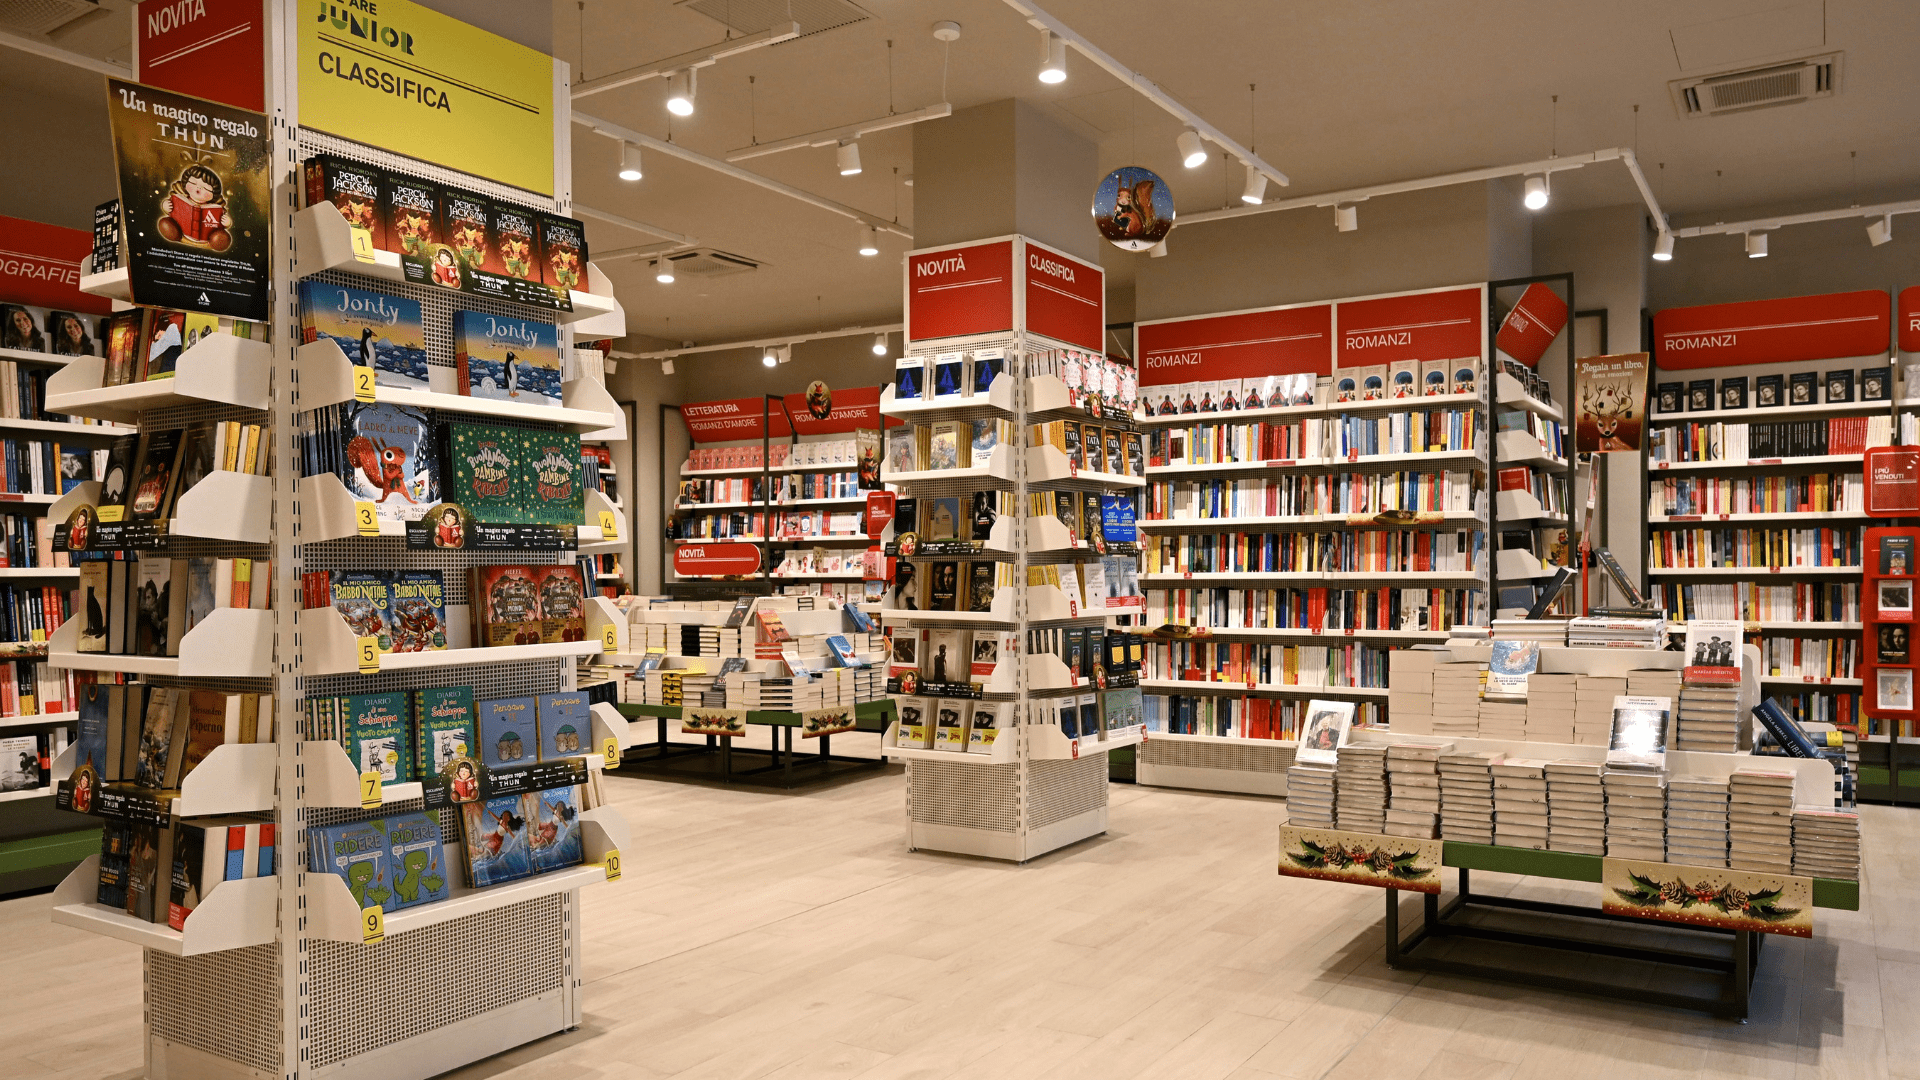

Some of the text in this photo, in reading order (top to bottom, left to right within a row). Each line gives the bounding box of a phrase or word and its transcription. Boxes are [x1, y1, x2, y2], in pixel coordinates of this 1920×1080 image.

[318, 1, 414, 56] JUNIOR
[318, 51, 452, 114] CLASSIFICA
[119, 88, 258, 138] Un magico regalo
[157, 122, 224, 150] THUN
[338, 170, 370, 185] PERCY
[332, 176, 378, 197] JACKSON
[397, 186, 426, 199] PERCY
[392, 191, 434, 210] JACKSON
[448, 204, 487, 223] JACKSON
[357, 236, 367, 252] 1
[916, 253, 966, 278] NOVITÀ
[1030, 254, 1076, 284] CLASSIFICA
[480, 280, 502, 290] THUN
[336, 289, 399, 327] Jonty
[485, 317, 538, 350] Jonty
[1346, 332, 1412, 350] ROMANZI
[1664, 335, 1737, 352] ROMANZI
[1146, 352, 1202, 368] ROMANZI
[1582, 362, 1608, 374] Regala
[1624, 361, 1644, 370] libro,
[1607, 370, 1634, 378] emozioni
[360, 374, 369, 391] 2
[684, 404, 740, 416] LETTERATURA
[831, 409, 868, 420] D'AMORE
[358, 421, 386, 433] LADRO
[691, 418, 758, 430] ROMANZI D'AMORE
[474, 464, 508, 482] BAMBINE
[538, 467, 570, 486] BAMBINE
[362, 510, 372, 525] 3
[604, 518, 612, 531] 4
[678, 546, 706, 558] NOVITÀ
[334, 584, 362, 600] BABBO
[392, 584, 418, 599] BABBO
[606, 632, 614, 646] 6
[364, 645, 374, 662] 5
[364, 698, 392, 706] DIARIO
[436, 691, 461, 699] DIARIO
[431, 703, 468, 720] Schiappa
[190, 718, 222, 734] Piperno
[358, 712, 398, 728] Schiappa
[430, 720, 448, 729] VUOTO
[1760, 708, 1776, 726] ANGELA
[1774, 725, 1788, 741] MERKEL
[356, 729, 376, 737] VUOTO
[608, 745, 615, 758] 8
[365, 780, 376, 796] 7
[499, 779, 520, 788] THUN
[390, 824, 436, 846] RIDERE
[334, 834, 382, 856] RIDERE
[606, 856, 619, 870] 10
[367, 914, 378, 931] 9
